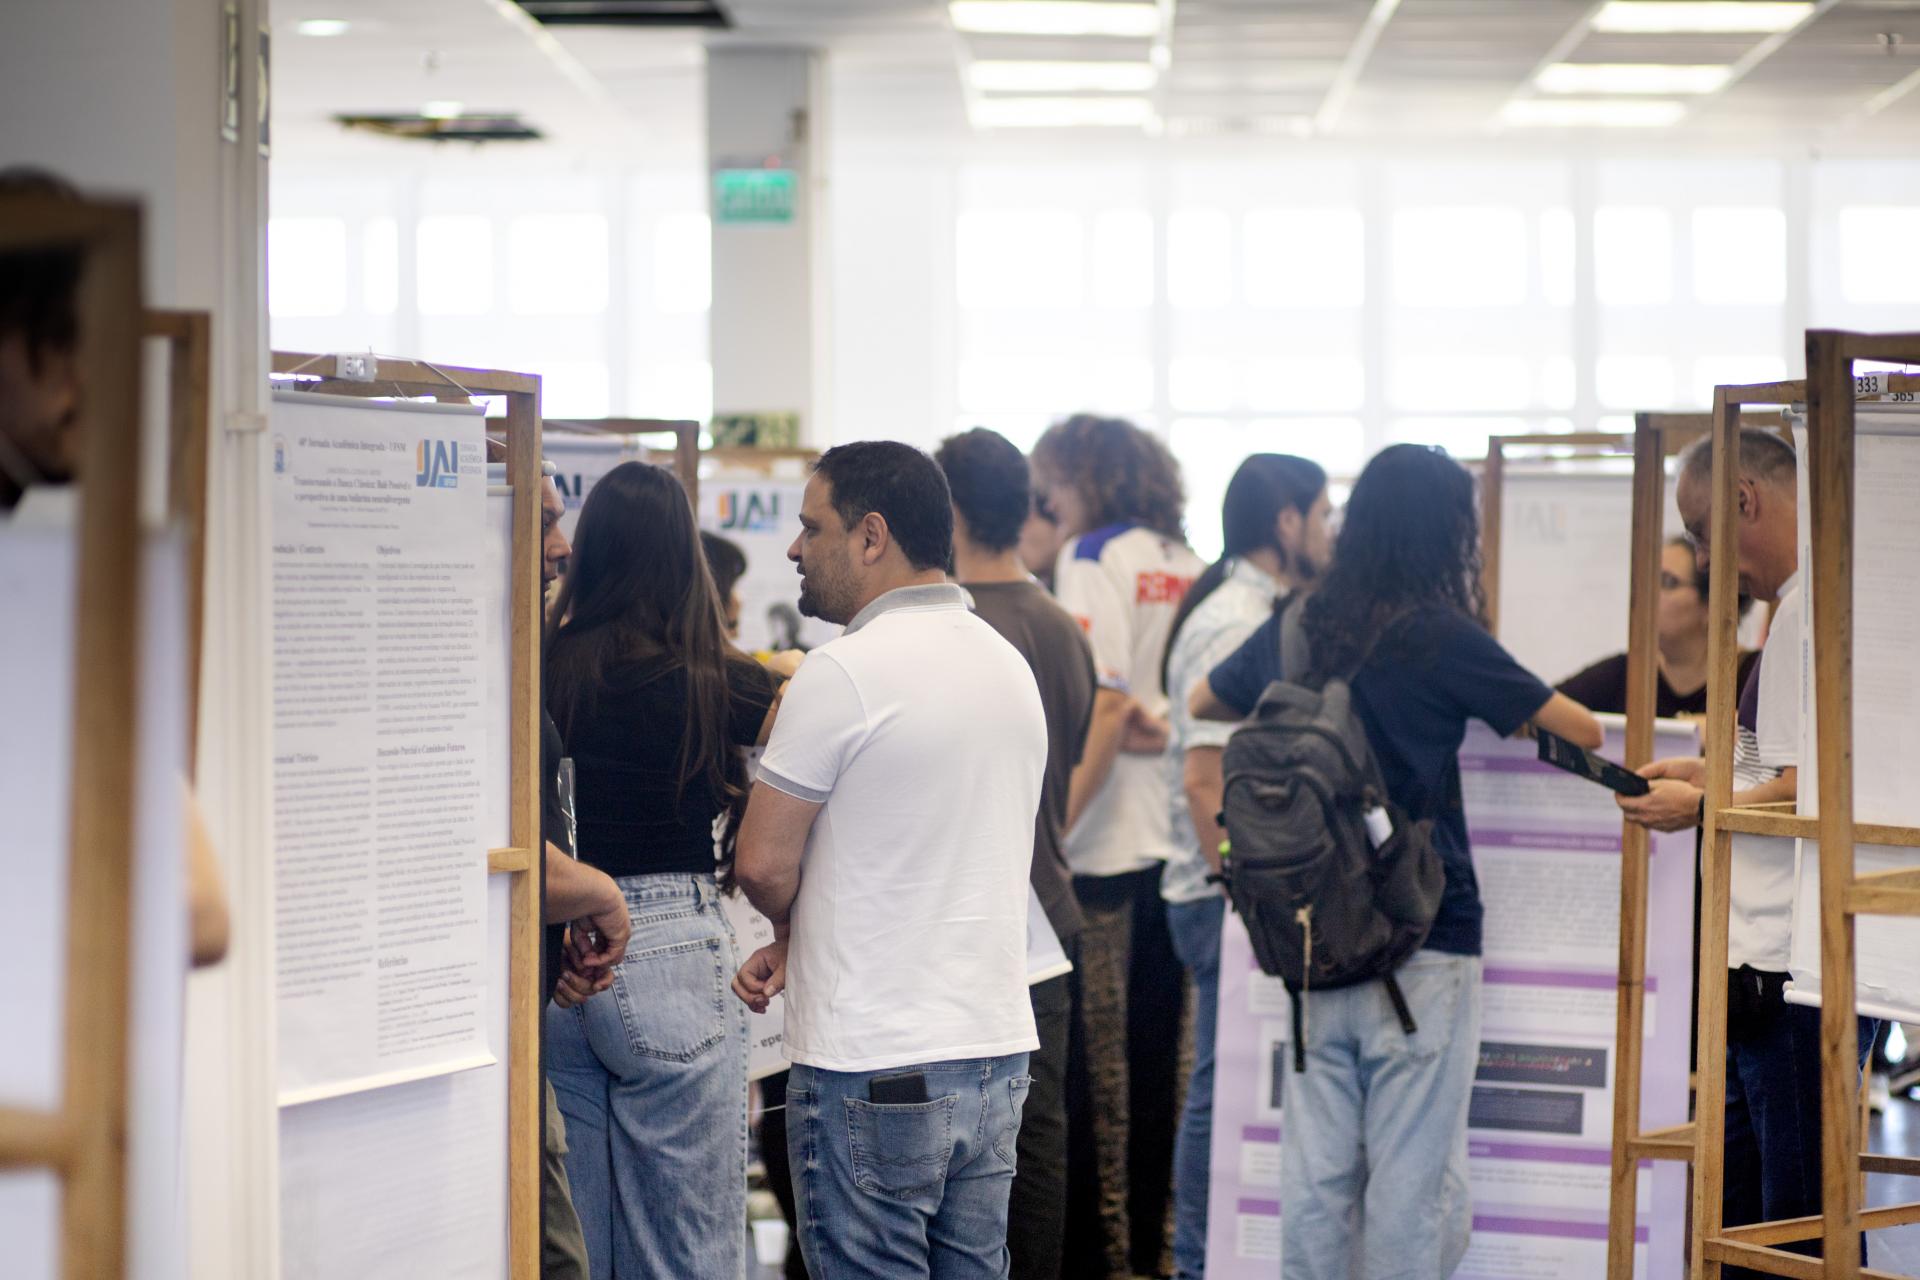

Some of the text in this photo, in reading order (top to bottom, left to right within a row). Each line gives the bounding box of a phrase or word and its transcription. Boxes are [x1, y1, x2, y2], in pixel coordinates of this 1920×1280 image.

[1857, 376, 1878, 393] 333
[416, 439, 458, 488] JAI
[719, 490, 780, 530] JAI
